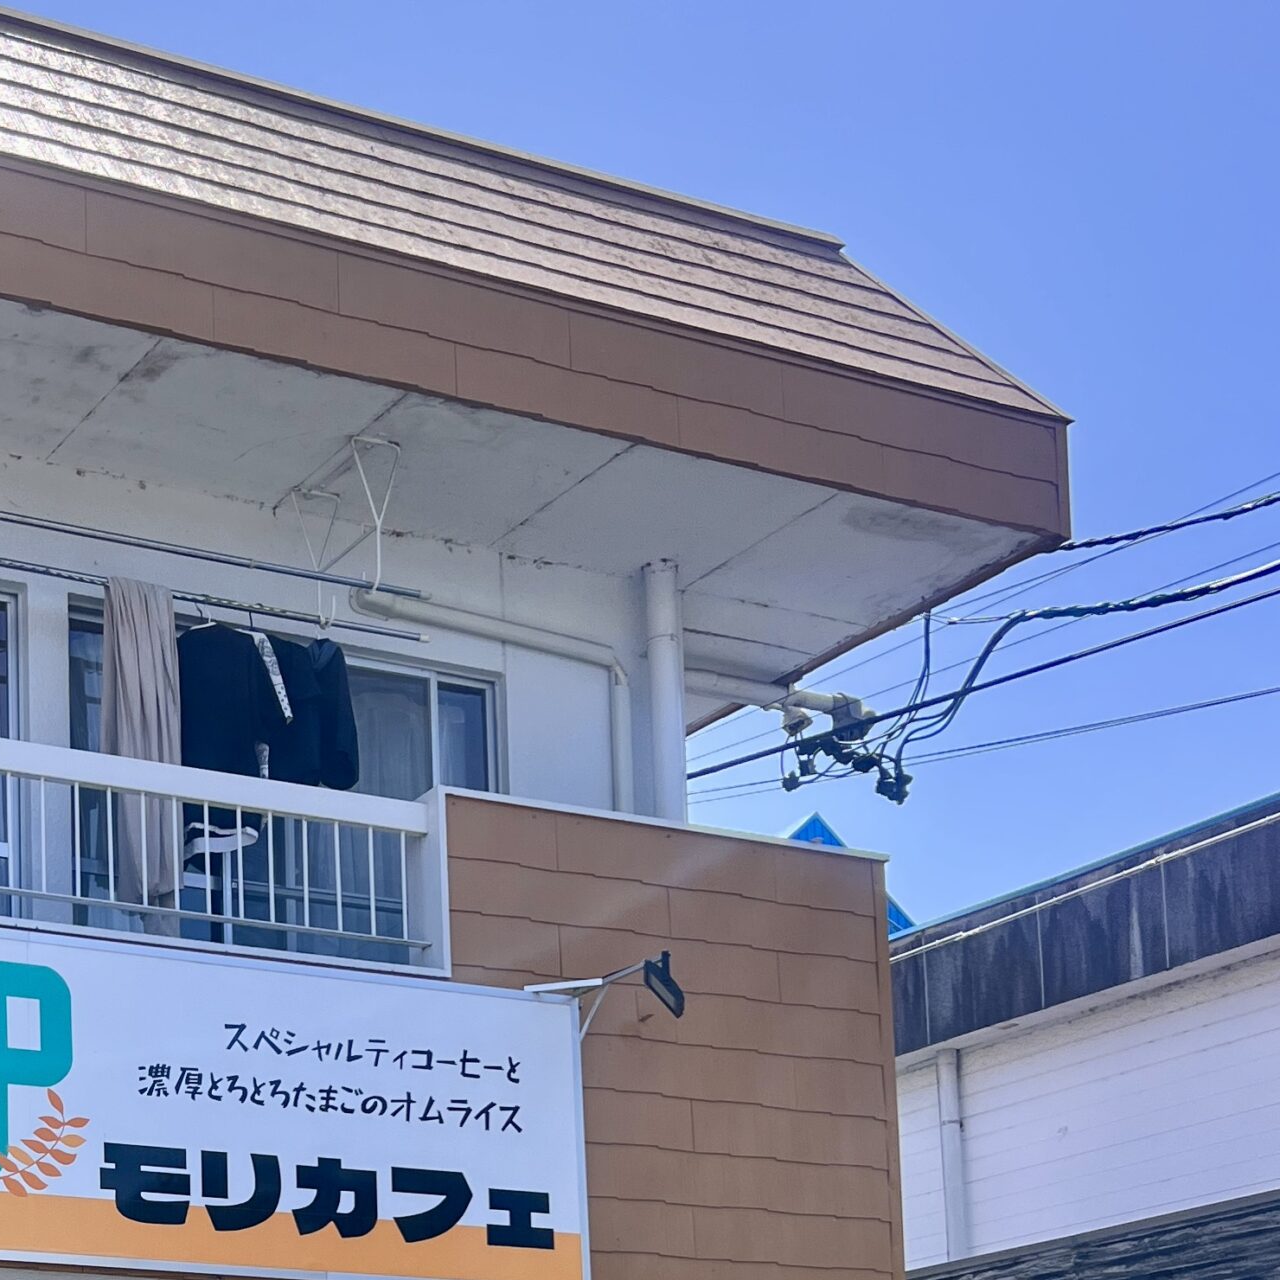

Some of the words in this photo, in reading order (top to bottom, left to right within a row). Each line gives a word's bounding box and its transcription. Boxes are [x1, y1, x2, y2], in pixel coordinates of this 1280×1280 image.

[223, 1022, 522, 1084] スペシャルティコーヒーと
[137, 1063, 523, 1134] 濃厚とろとろたまごのオムライス
[99, 1141, 555, 1250] モリカフェ
